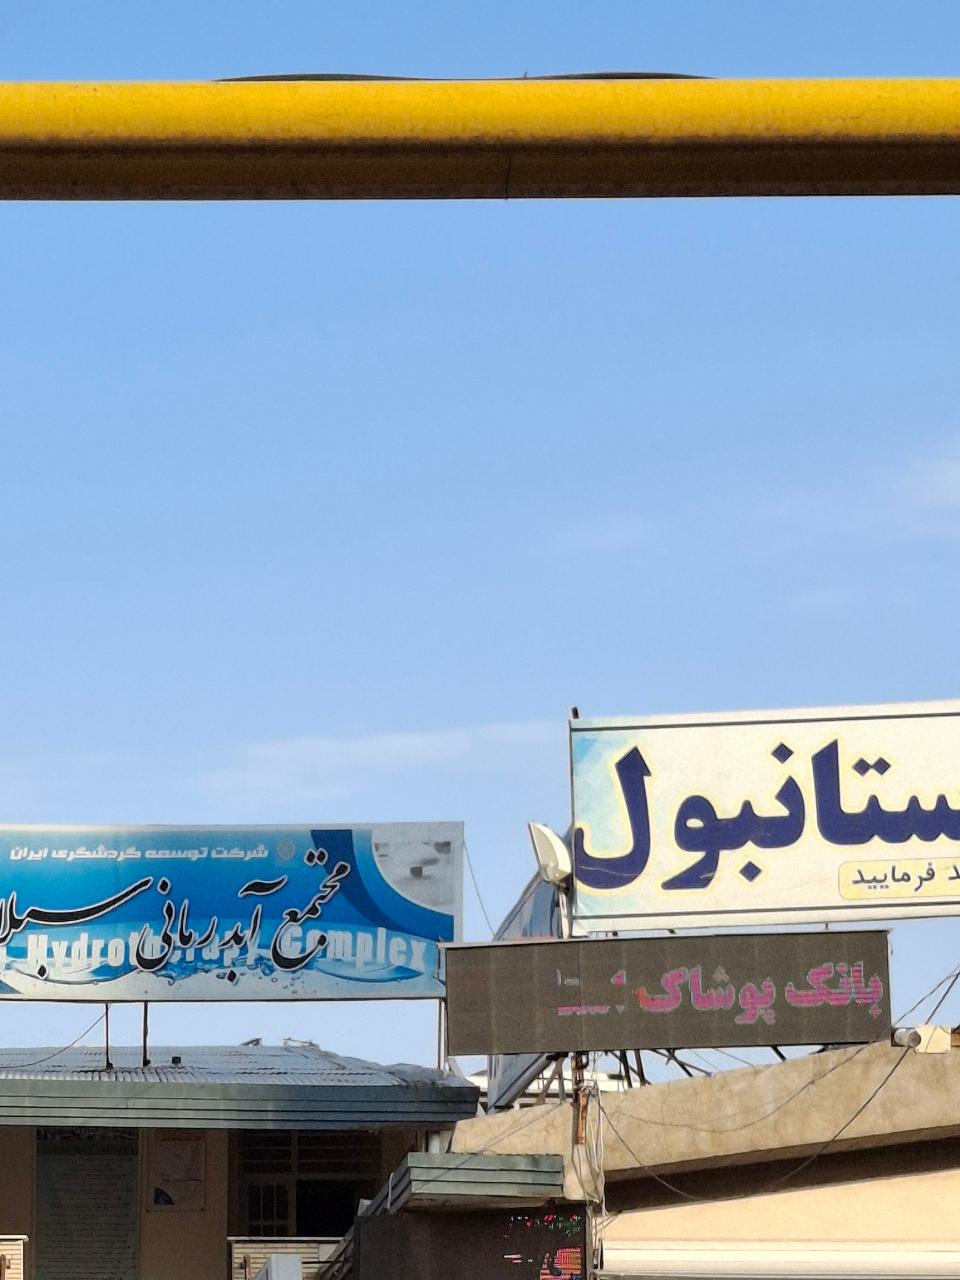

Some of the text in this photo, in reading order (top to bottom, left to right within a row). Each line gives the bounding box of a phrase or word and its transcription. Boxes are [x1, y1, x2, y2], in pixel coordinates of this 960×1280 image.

[9, 846, 49, 861] ایران
[144, 845, 209, 862] توسعه
[211, 843, 269, 862] شرکت
[851, 861, 936, 892] فرمایید
[270, 847, 352, 973] مجتمع
[637, 964, 776, 1025] پوشاک
[784, 960, 883, 1018] بانک
